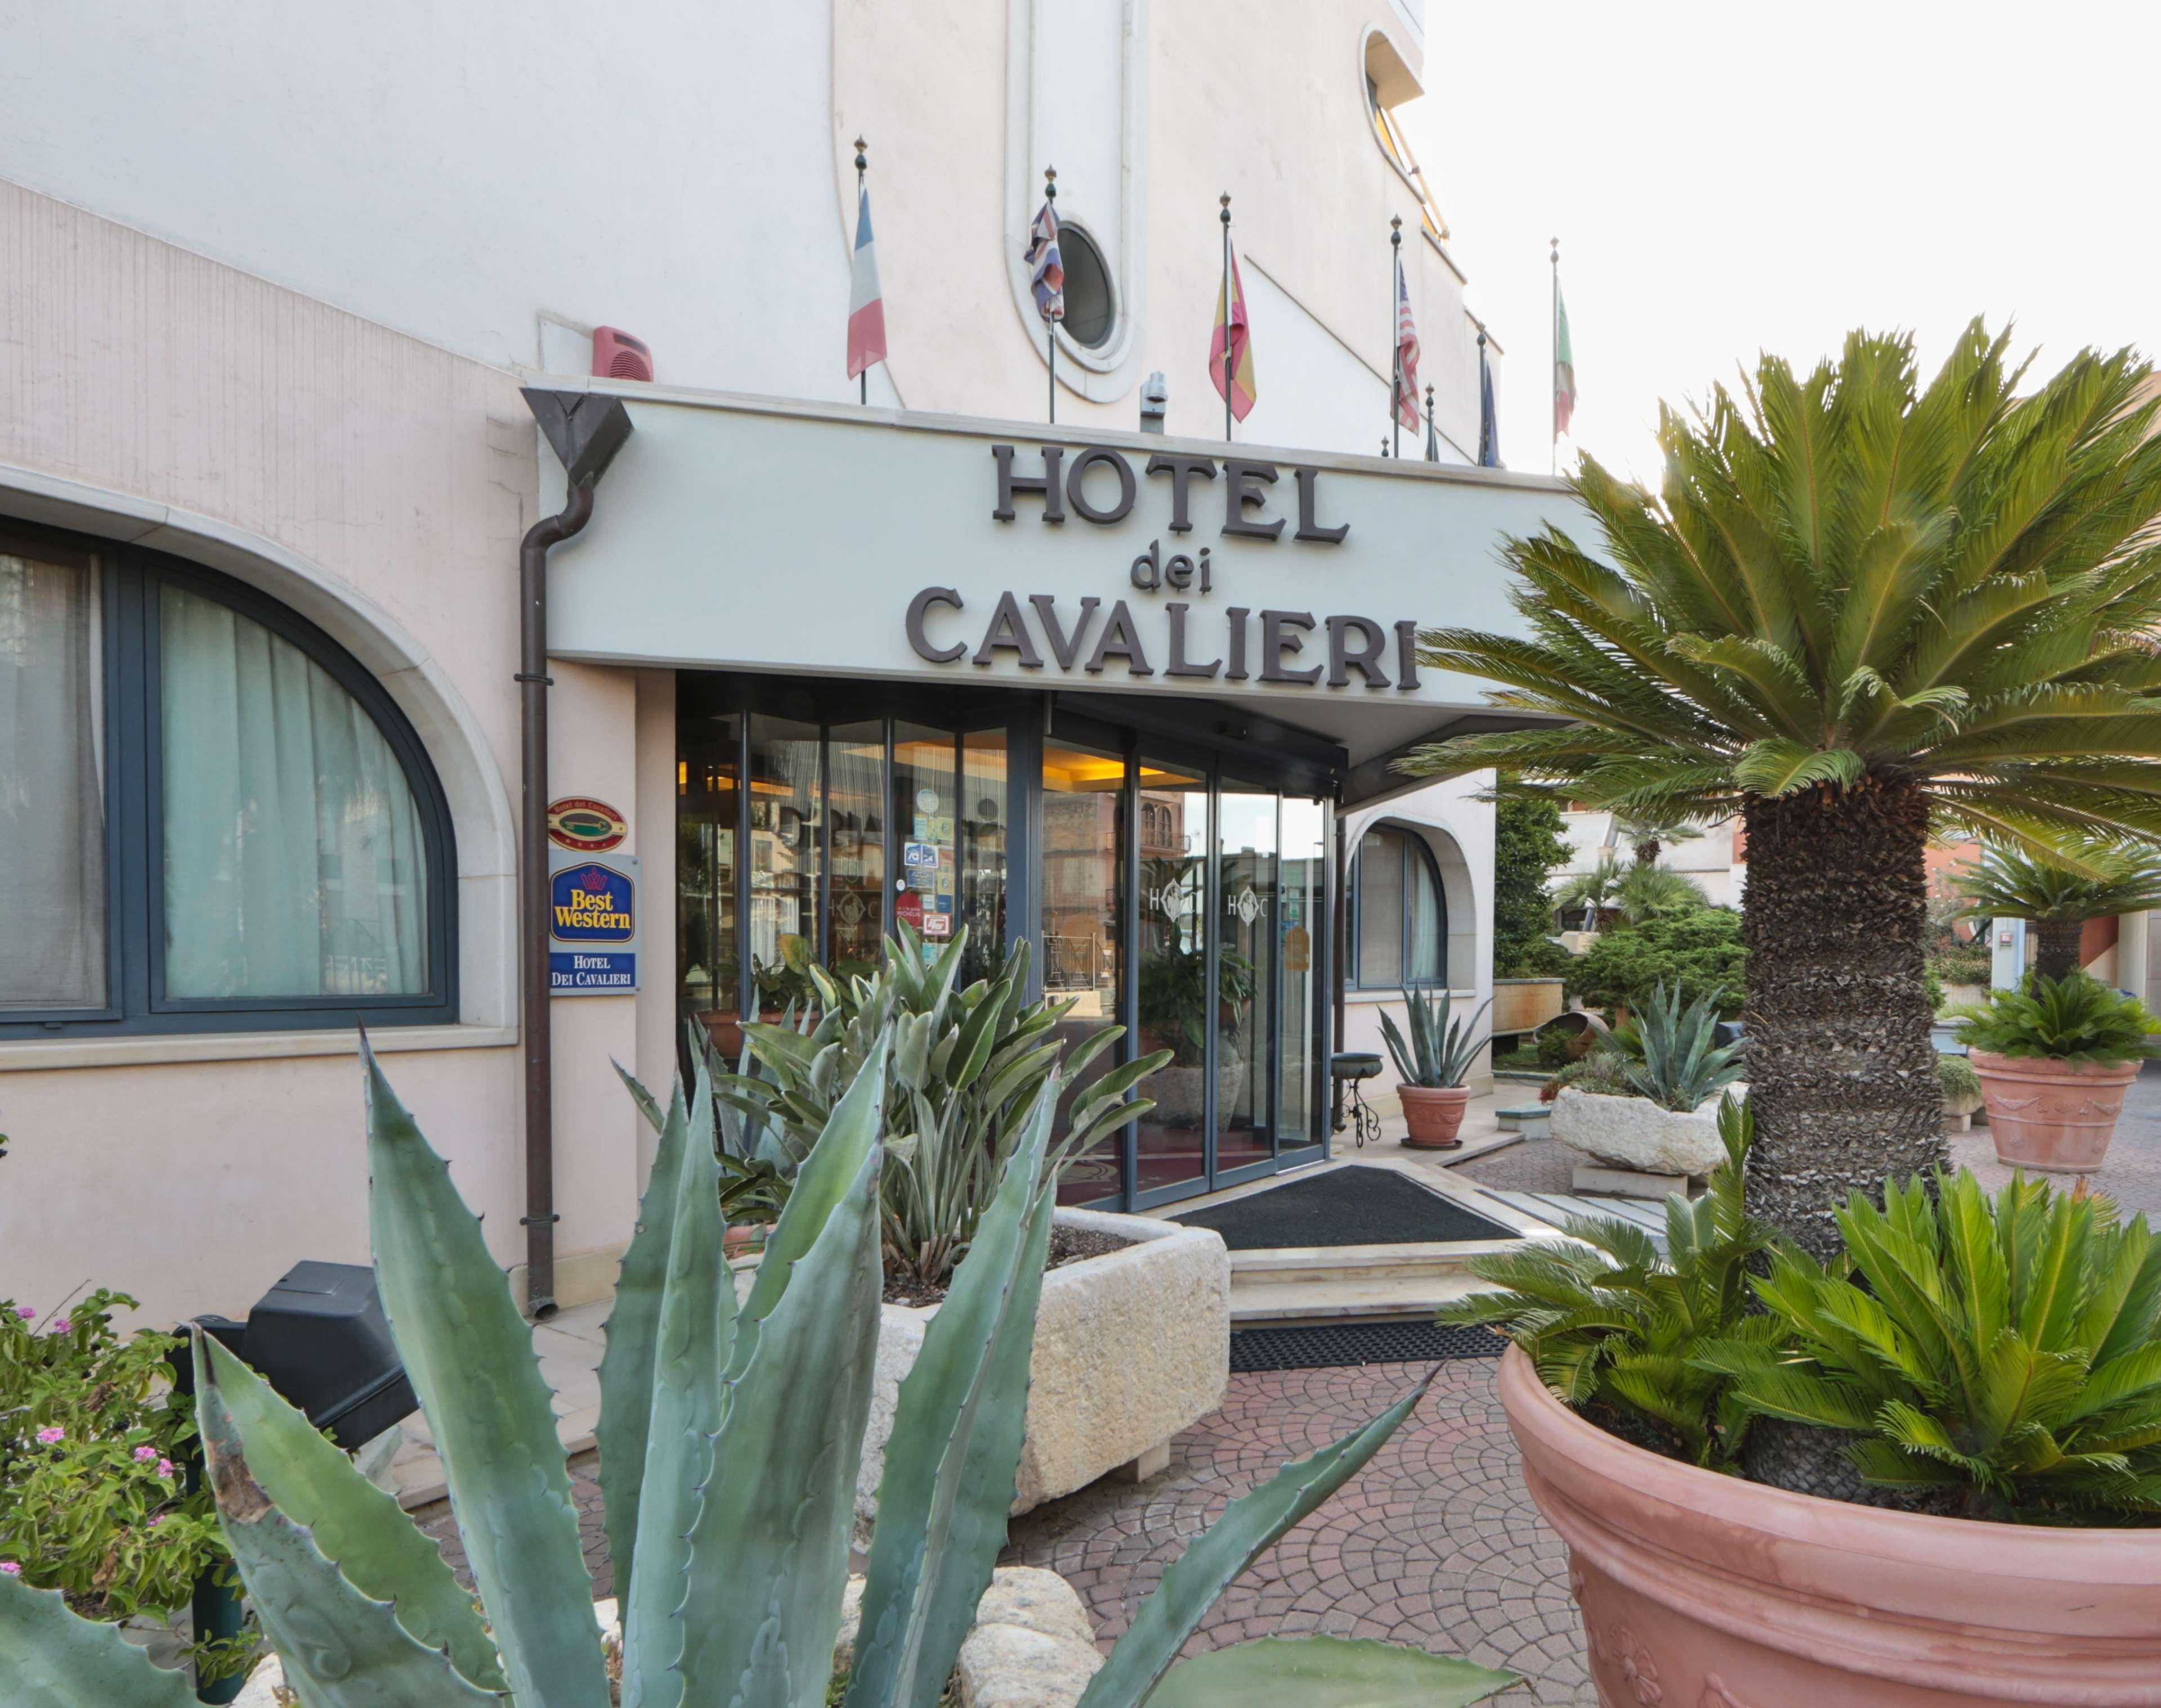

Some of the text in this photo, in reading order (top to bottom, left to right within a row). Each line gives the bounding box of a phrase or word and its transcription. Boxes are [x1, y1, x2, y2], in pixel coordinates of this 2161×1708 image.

[992, 444, 1350, 545] HOTEL
[1130, 539, 1213, 594] dei
[905, 586, 1421, 691] CAVALIERI
[553, 801, 572, 813] Hotel
[588, 802, 619, 820] Cavalieri
[570, 889, 614, 911] Best
[554, 904, 631, 929] Western
[573, 955, 611, 969] HOTEL
